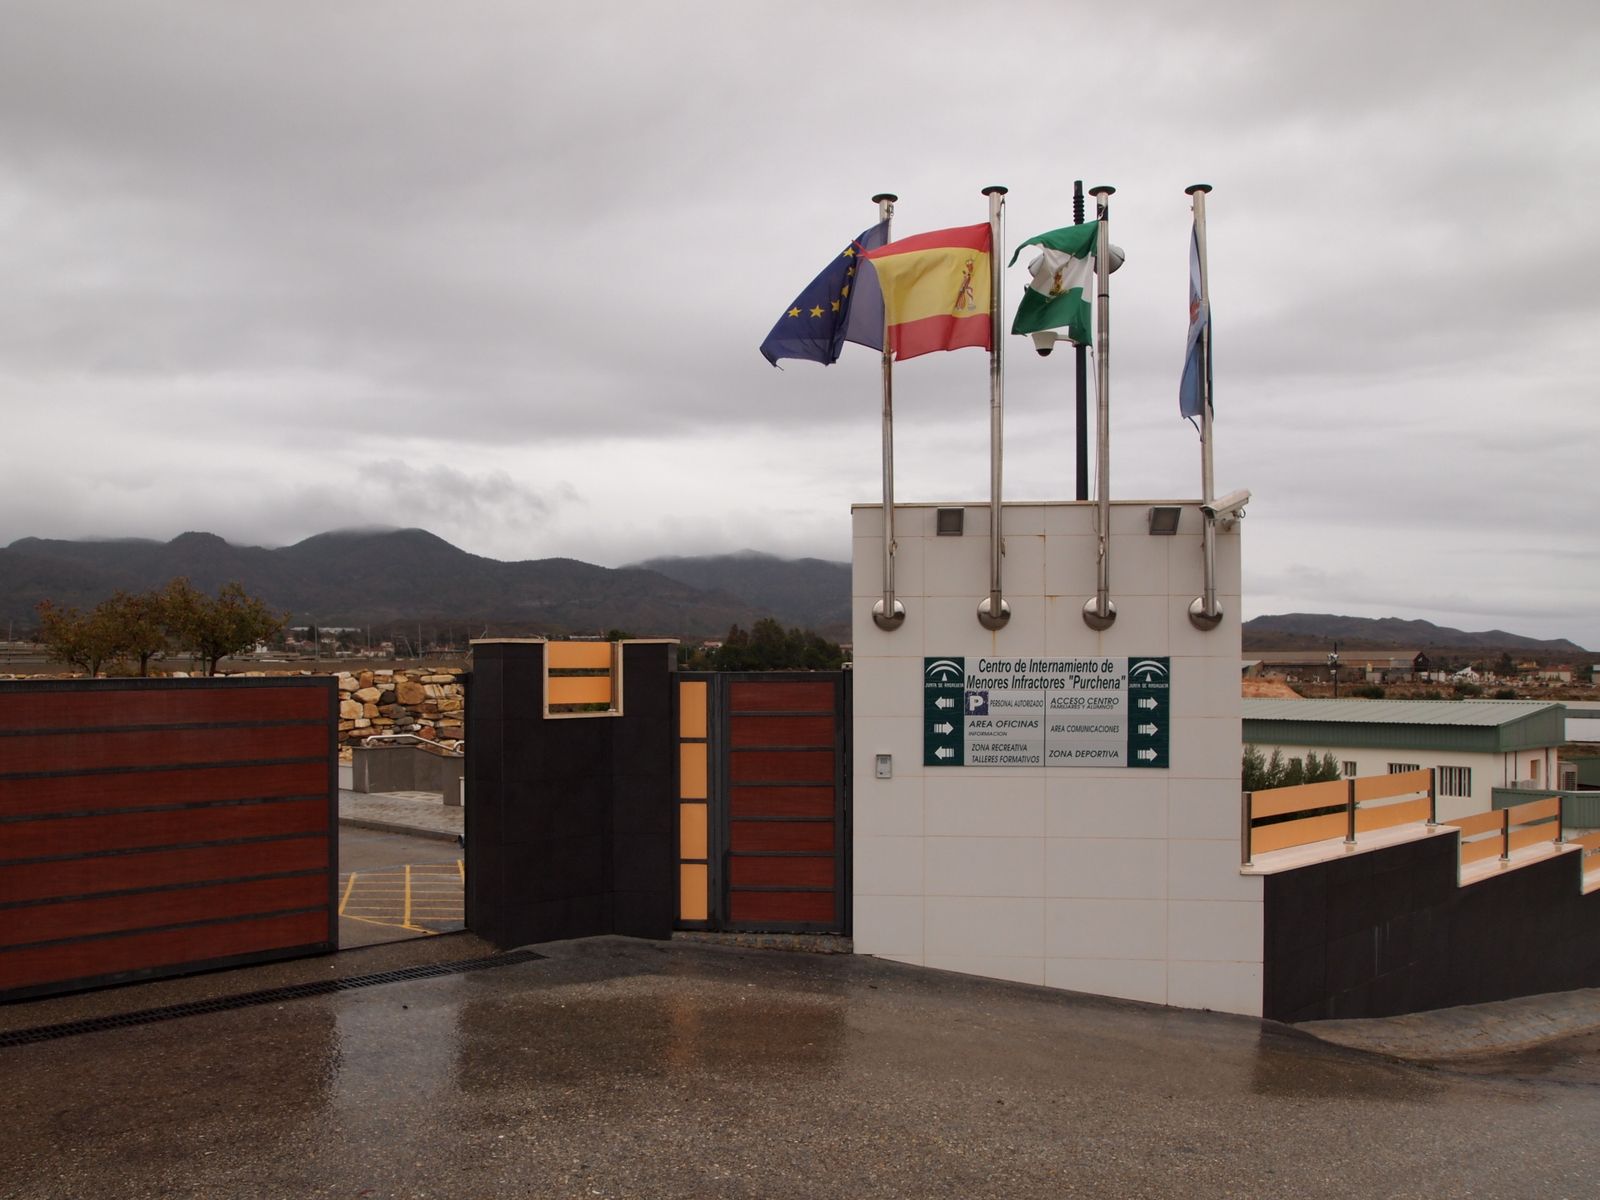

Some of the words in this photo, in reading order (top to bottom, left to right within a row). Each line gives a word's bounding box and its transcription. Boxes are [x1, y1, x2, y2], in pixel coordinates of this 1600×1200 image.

[979, 658, 1011, 673] Centro
[1014, 659, 1027, 673] de
[1029, 658, 1098, 673] Internamiento
[1101, 658, 1114, 673] de
[966, 675, 1008, 689] Menores
[1011, 675, 1065, 689] Infractores
[1069, 675, 1126, 689] "Purchena"
[969, 695, 984, 712] P
[990, 699, 1013, 707] PERSONAL
[1014, 699, 1043, 707] AUTORIZADO
[1050, 697, 1085, 705] ACCESO
[1087, 697, 1119, 705] CENTRO
[969, 720, 993, 728] AREA
[996, 720, 1039, 728] OFICINAS
[1050, 725, 1065, 733] AREA
[1066, 725, 1119, 733] COMUNICACIONES
[972, 743, 989, 751] ZONA
[991, 743, 1028, 751] RECREATIVA
[1048, 750, 1073, 758] ZONA
[1075, 750, 1119, 758] DEPORTIVA
[972, 755, 998, 763] TALLERES
[1000, 755, 1040, 763] FORMATIVOS
